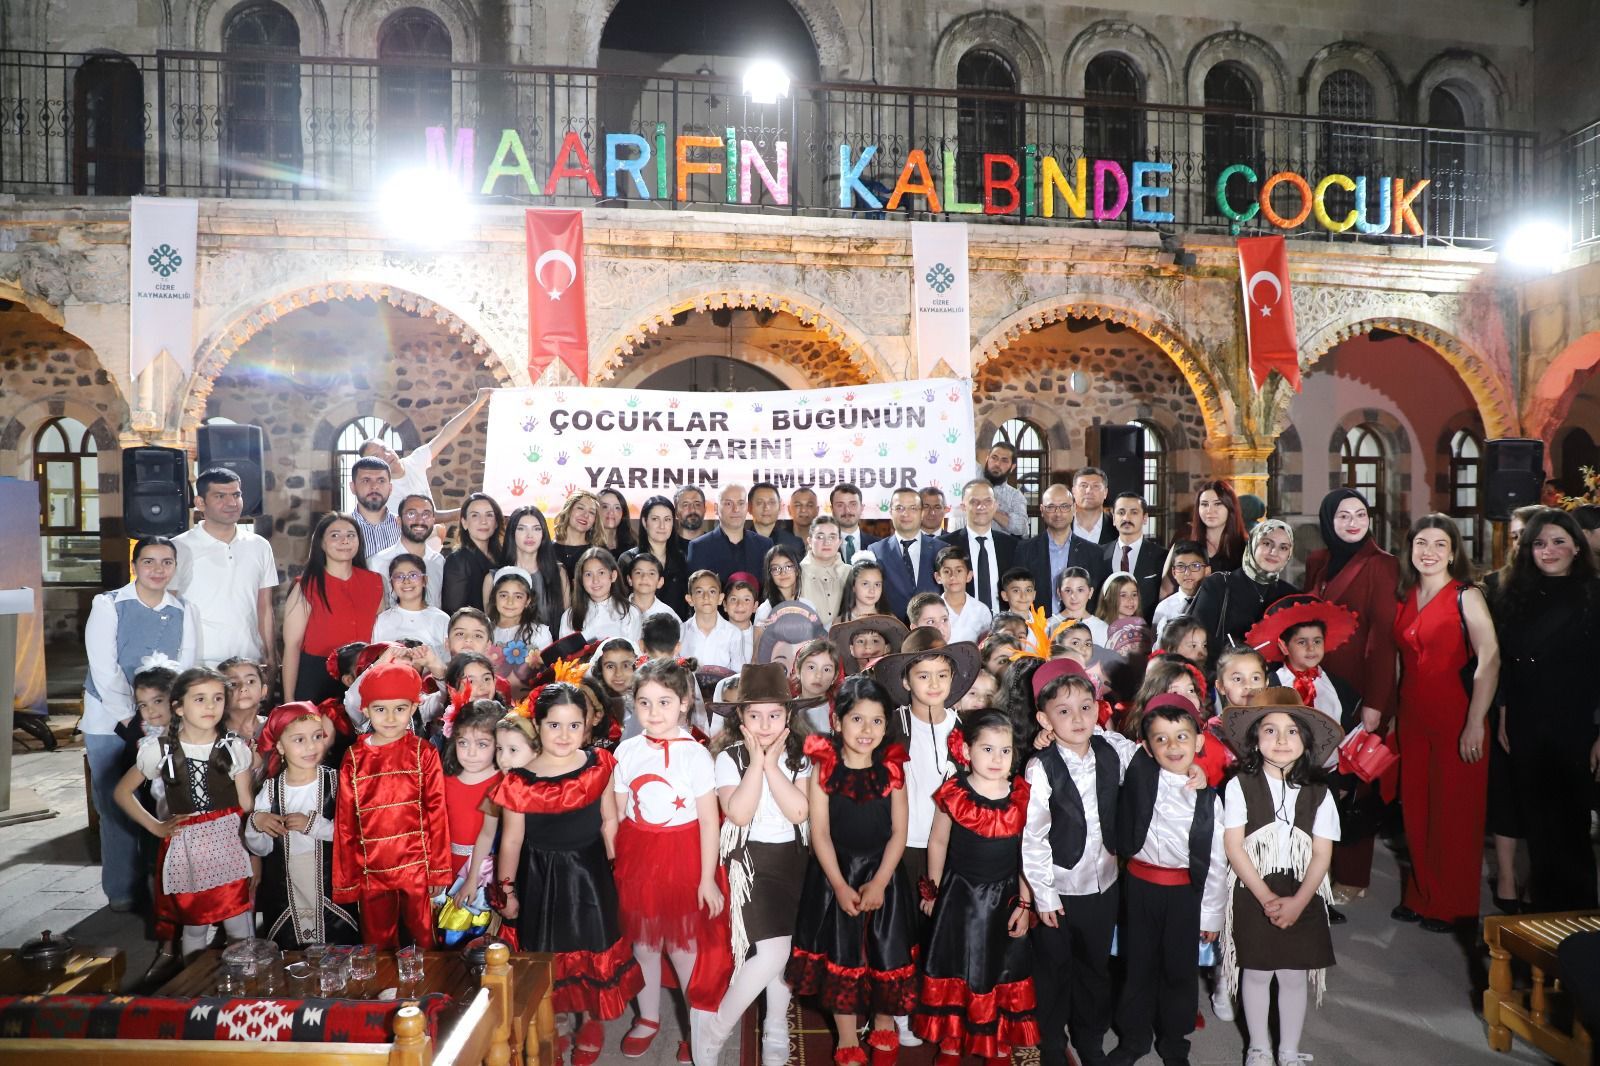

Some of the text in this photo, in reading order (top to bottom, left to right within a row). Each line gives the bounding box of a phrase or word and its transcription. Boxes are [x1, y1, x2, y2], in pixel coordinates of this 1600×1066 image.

[425, 123, 1431, 236] MAARİFİN KALBİNDE ÇOCUK
[155, 283, 176, 291] CİZRE
[550, 402, 926, 436] ÇOCUKLAR BUGÜNÜN
[683, 437, 792, 460] YARINI
[584, 466, 918, 489] YARININ UMUDUDUR
